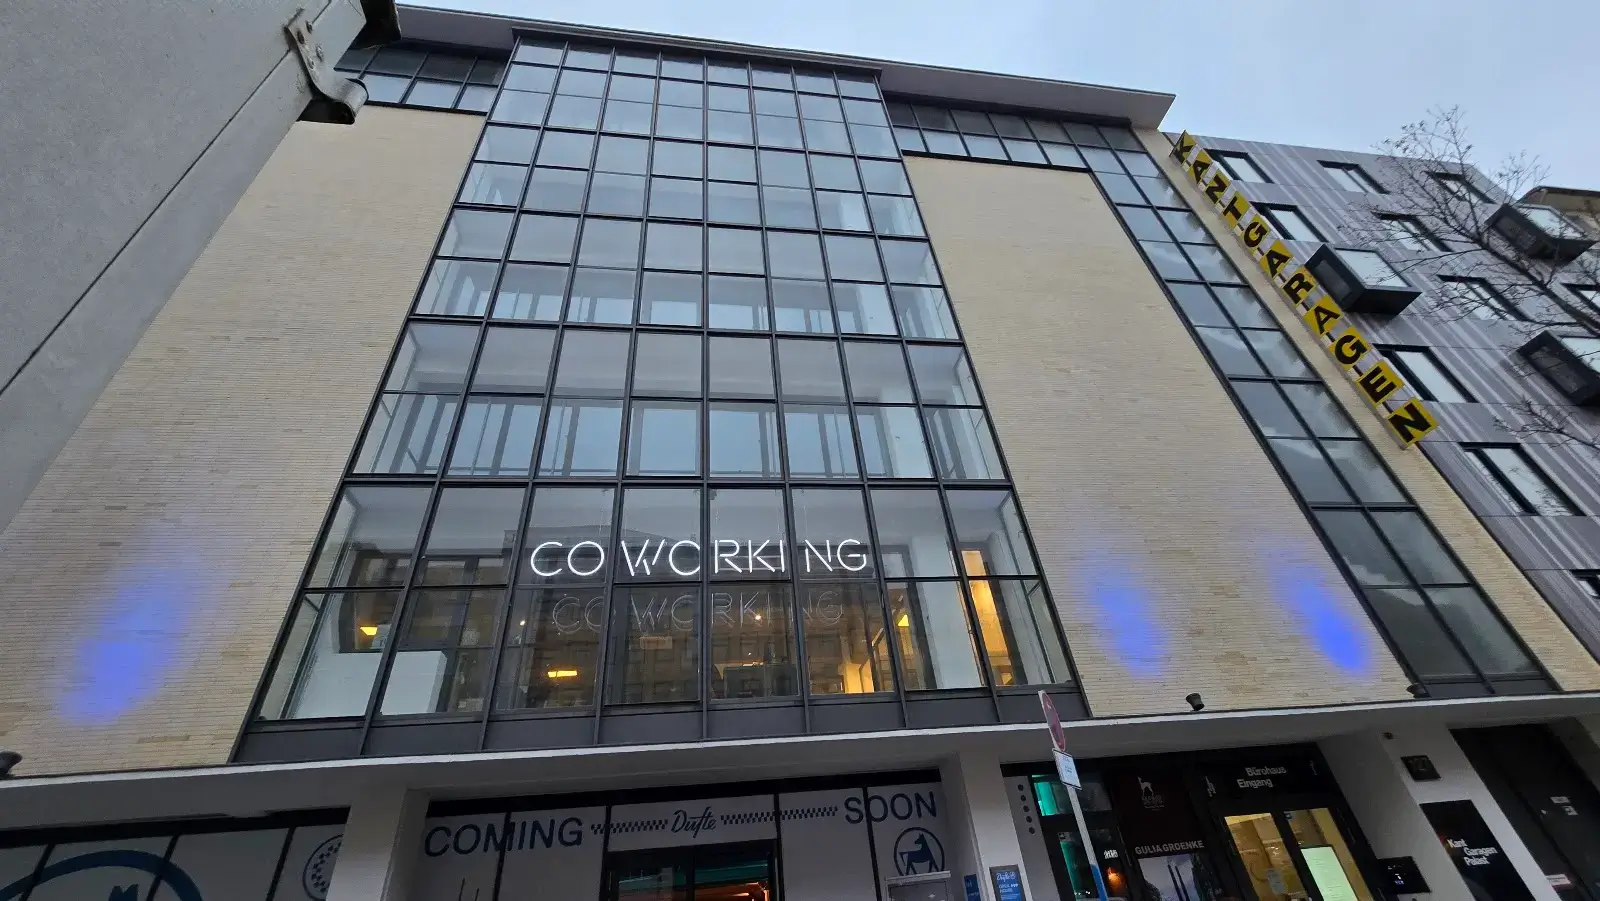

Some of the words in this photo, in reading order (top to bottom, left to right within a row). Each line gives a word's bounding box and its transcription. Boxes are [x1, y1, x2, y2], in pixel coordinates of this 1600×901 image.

[1172, 136, 1432, 443] KANTGARAGEN
[530, 538, 867, 577] COWORKING
[1244, 766, 1288, 777] Bürohaus
[1236, 778, 1275, 789] Eingang
[844, 790, 937, 825] SOON
[670, 805, 718, 838] Dufte
[424, 816, 583, 858] COMING
[1447, 838, 1468, 848] Kant
[1162, 840, 1205, 852] GROENKE
[1463, 847, 1499, 857] Garagen
[1463, 855, 1491, 866] Palast
